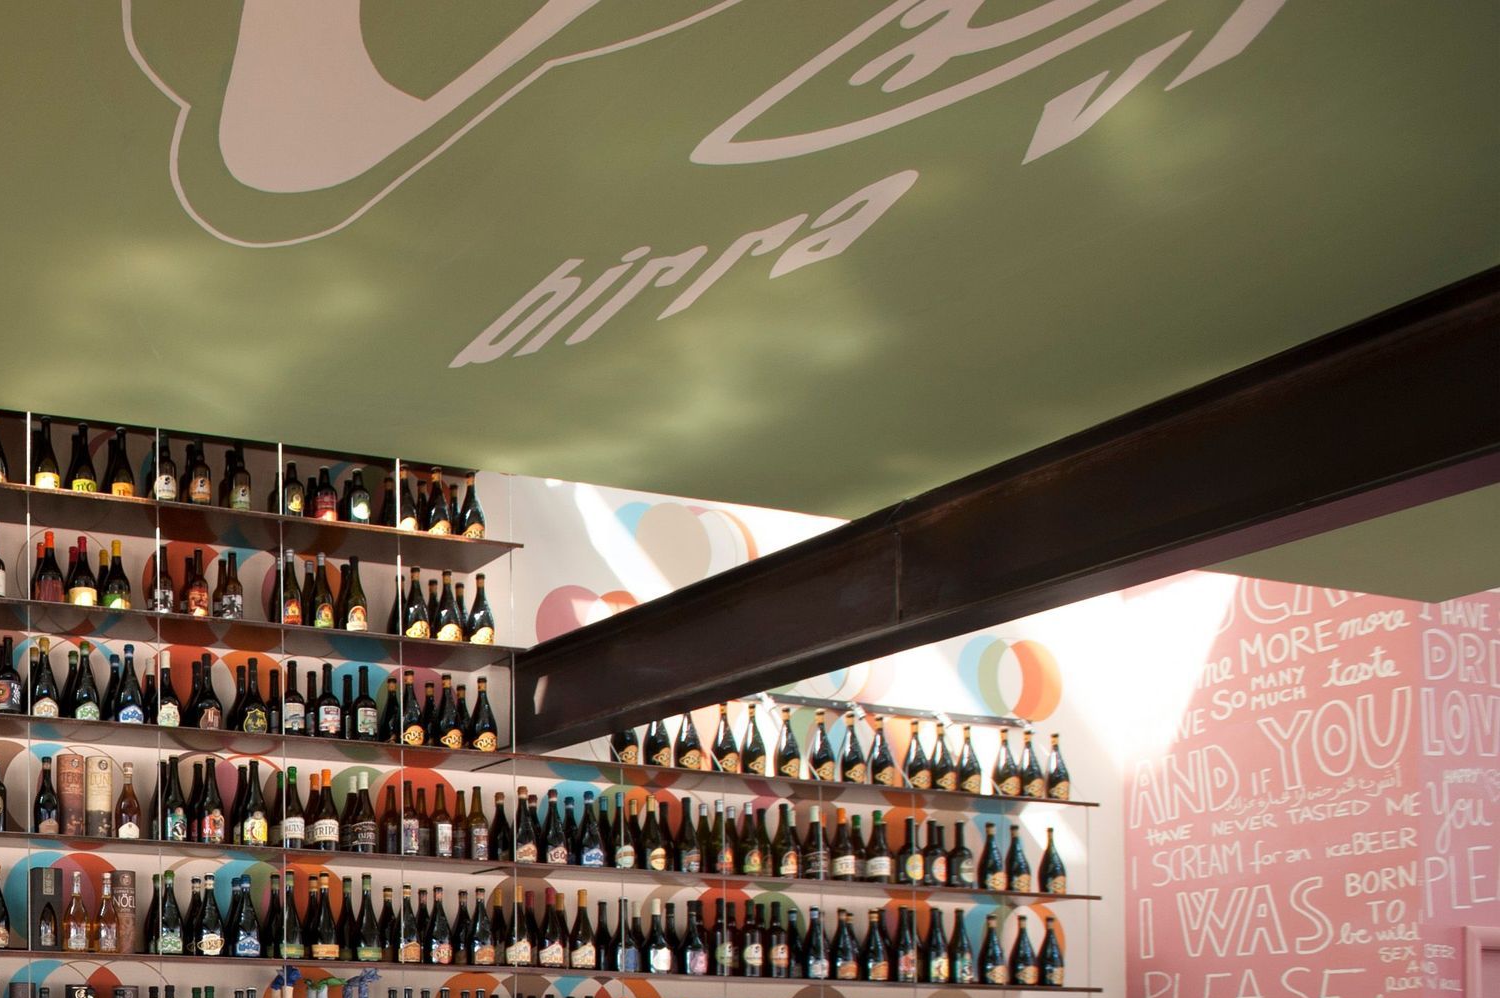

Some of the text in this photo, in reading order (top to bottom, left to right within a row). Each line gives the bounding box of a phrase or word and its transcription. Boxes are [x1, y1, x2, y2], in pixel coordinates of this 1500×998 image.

[449, 169, 919, 368] birra
[1239, 619, 1339, 675] MORE
[1338, 609, 1411, 641] more
[1210, 689, 1248, 721] SO
[1250, 666, 1305, 690] MANY
[1322, 645, 1401, 687] taste
[1250, 686, 1307, 711] MUCH
[1130, 685, 1412, 829] AND IF YOU
[1145, 823, 1194, 846] HAVE
[1212, 813, 1278, 837] NEVER
[1285, 800, 1371, 825] TASTED
[1385, 791, 1422, 817] ME
[1152, 840, 1244, 887] SCREAM
[1250, 840, 1280, 874] for
[1286, 847, 1312, 863] an
[1139, 860, 1417, 960] I WAS BORN
[1335, 921, 1422, 946] be wild
[1366, 898, 1406, 925] TO
[1378, 945, 1417, 963] SEX
